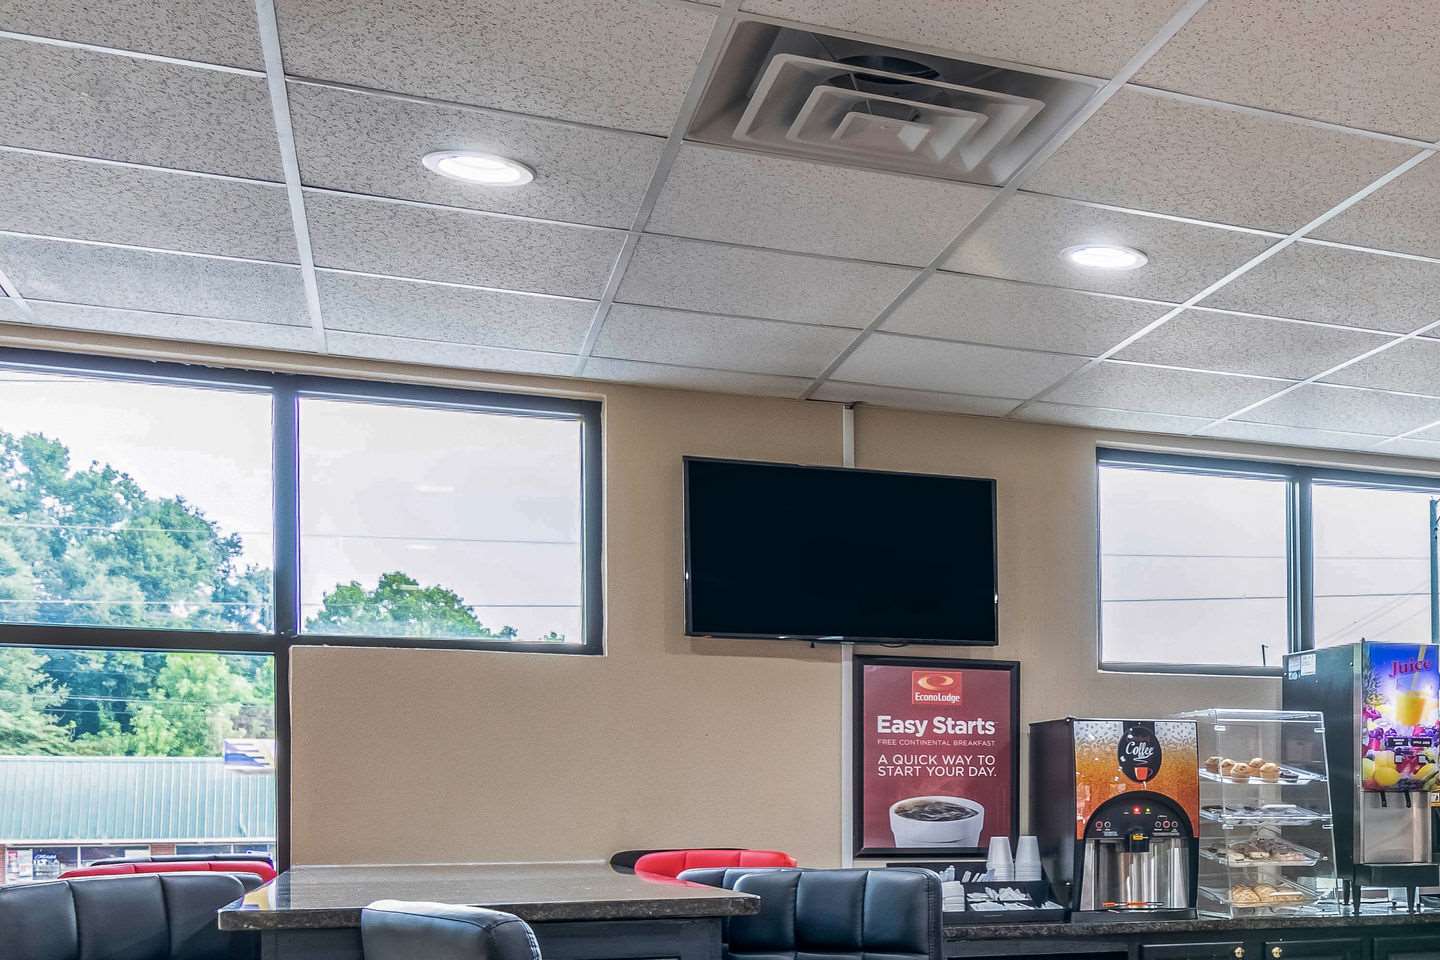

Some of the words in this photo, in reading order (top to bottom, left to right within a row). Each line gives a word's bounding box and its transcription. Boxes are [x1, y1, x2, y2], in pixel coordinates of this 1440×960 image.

[1389, 656, 1432, 679] Juice
[877, 714, 928, 738] Easy
[932, 715, 996, 735] Starts
[877, 738, 897, 746] FREE
[898, 738, 951, 748] CONTINENTAL
[953, 739, 996, 748] BREAKFAST
[1125, 741, 1155, 761] Coffee
[877, 754, 888, 765] A
[892, 754, 938, 766] QUICK
[941, 754, 973, 766] WAY
[977, 755, 996, 766] TO
[877, 765, 922, 777] START
[925, 765, 965, 777] YOUR
[968, 766, 998, 777] DAY.
